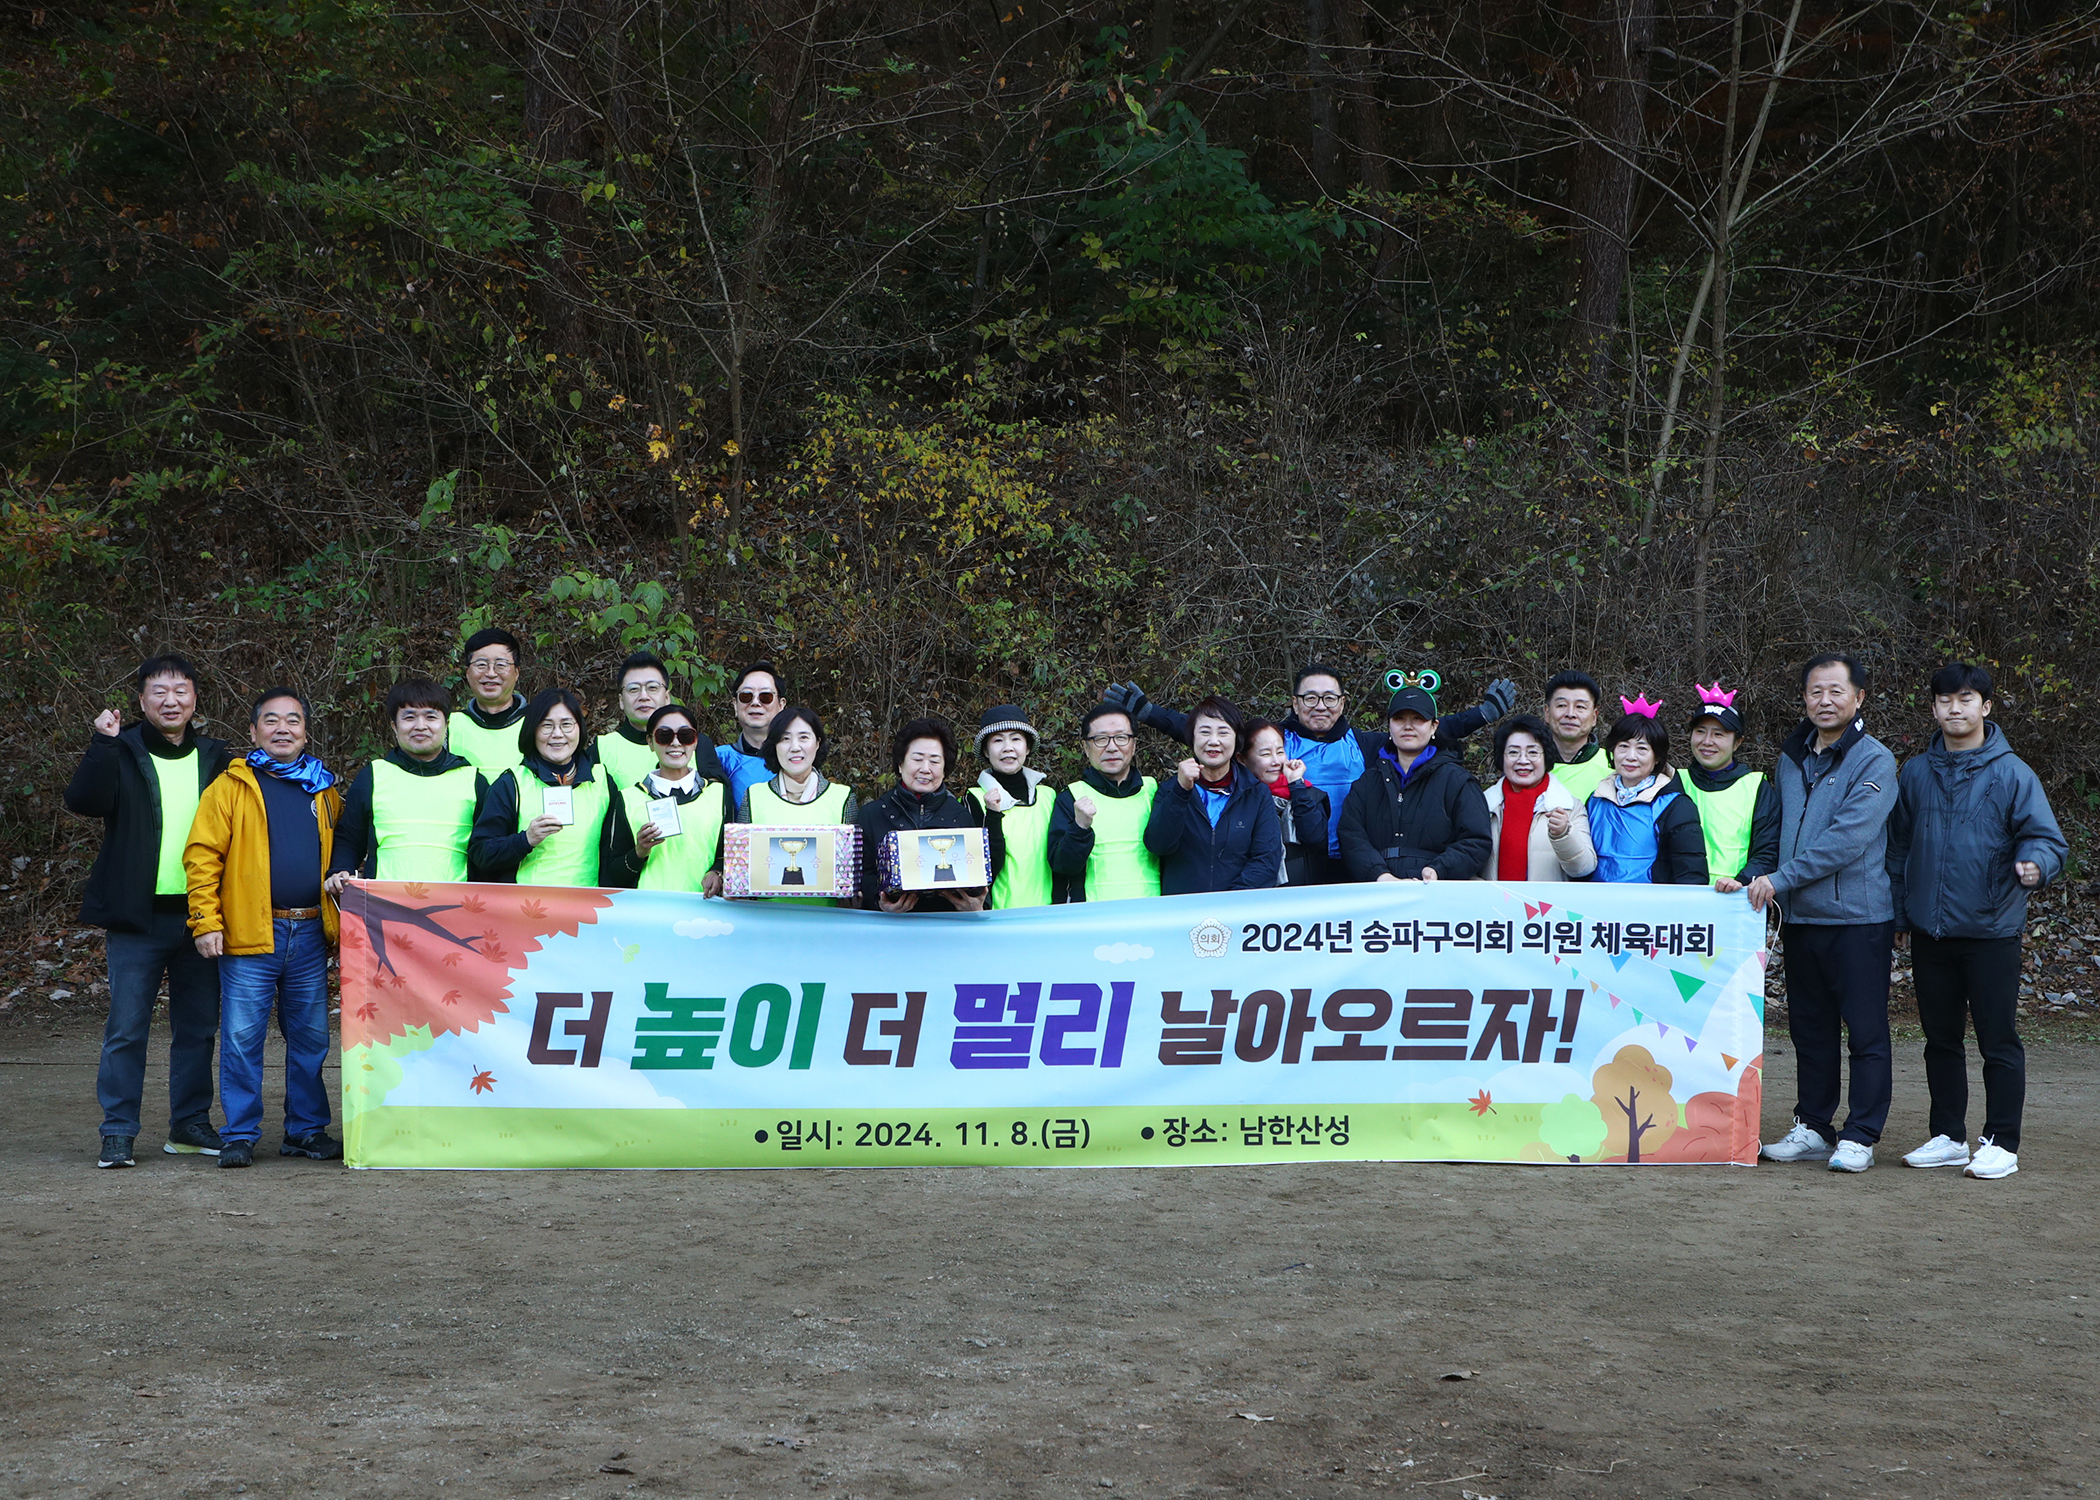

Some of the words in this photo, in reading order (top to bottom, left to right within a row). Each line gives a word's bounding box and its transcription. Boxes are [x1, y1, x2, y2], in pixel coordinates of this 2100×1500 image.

[1199, 933, 1221, 945] 의회
[1242, 920, 1353, 953] 2024년
[1361, 920, 1513, 954] 송파구의회
[1521, 921, 1582, 954] 의원
[1590, 922, 1714, 957] 체육대회
[527, 991, 614, 1069] 더
[630, 982, 827, 1070] 높이
[843, 991, 928, 1069] 더
[950, 981, 1136, 1069] 멀리
[1158, 988, 1585, 1067] 날아오르자!
[776, 1120, 843, 1151] 일시:
[855, 1122, 942, 1148] 2024.
[955, 1122, 1000, 1147] 11.
[1011, 1118, 1091, 1150] 8.(금)
[1162, 1116, 1228, 1149] 장소:
[1240, 1115, 1351, 1147] 남한산성
